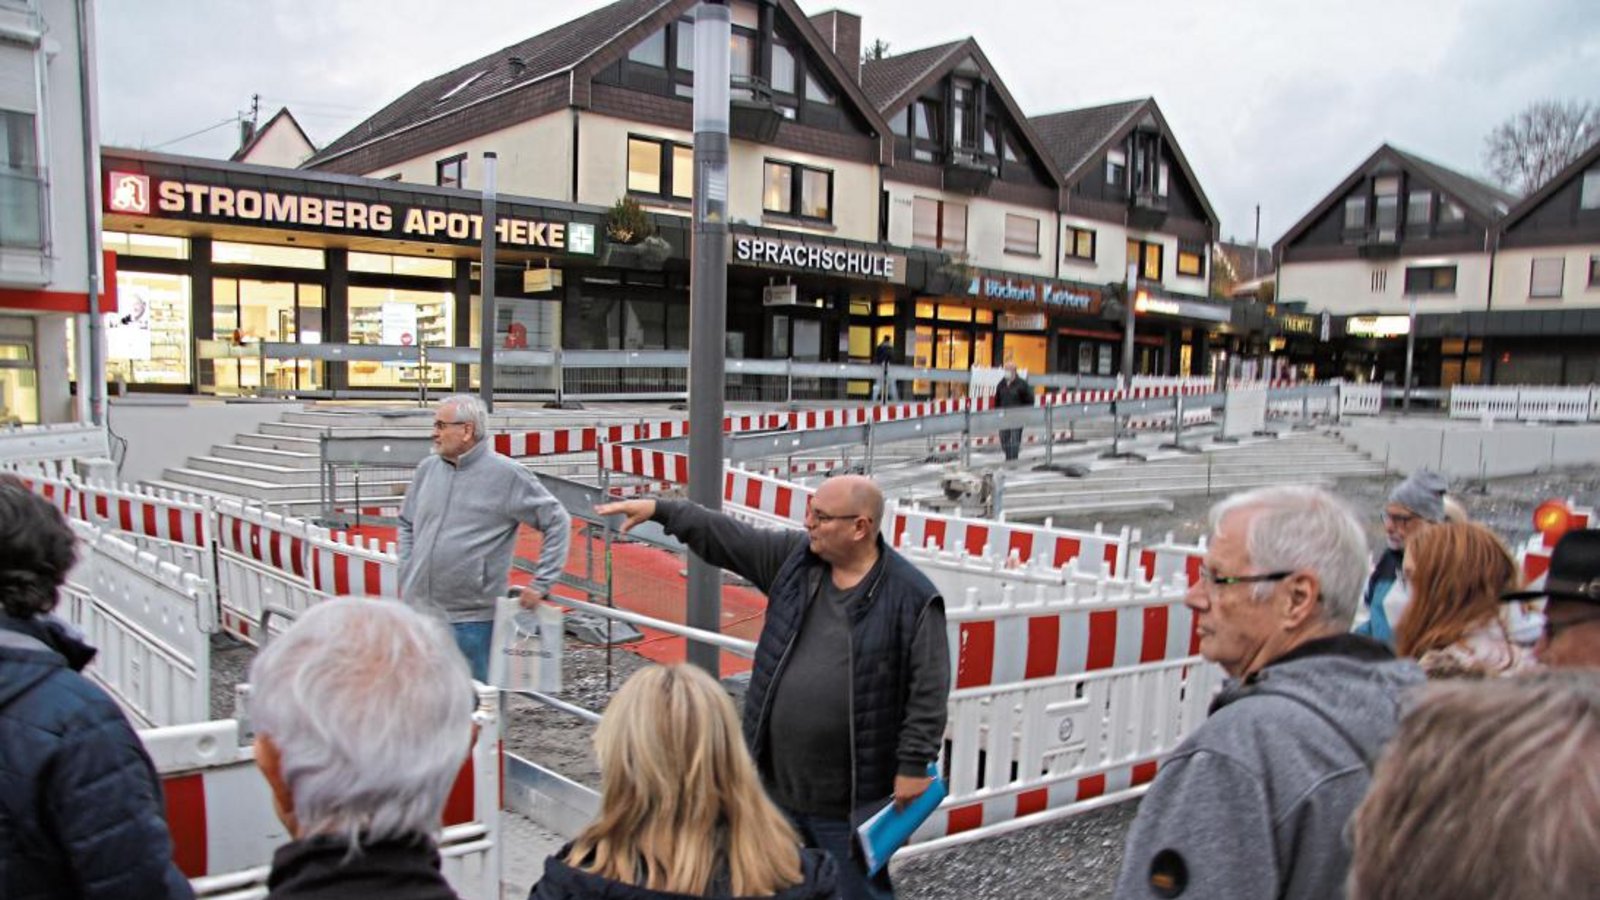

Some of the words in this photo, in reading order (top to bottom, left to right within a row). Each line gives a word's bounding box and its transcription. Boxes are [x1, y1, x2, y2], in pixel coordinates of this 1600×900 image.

[158, 180, 392, 231] STROMBERG
[403, 208, 566, 249] APOTHEKE
[737, 238, 895, 277] SPRACHSCHULE
